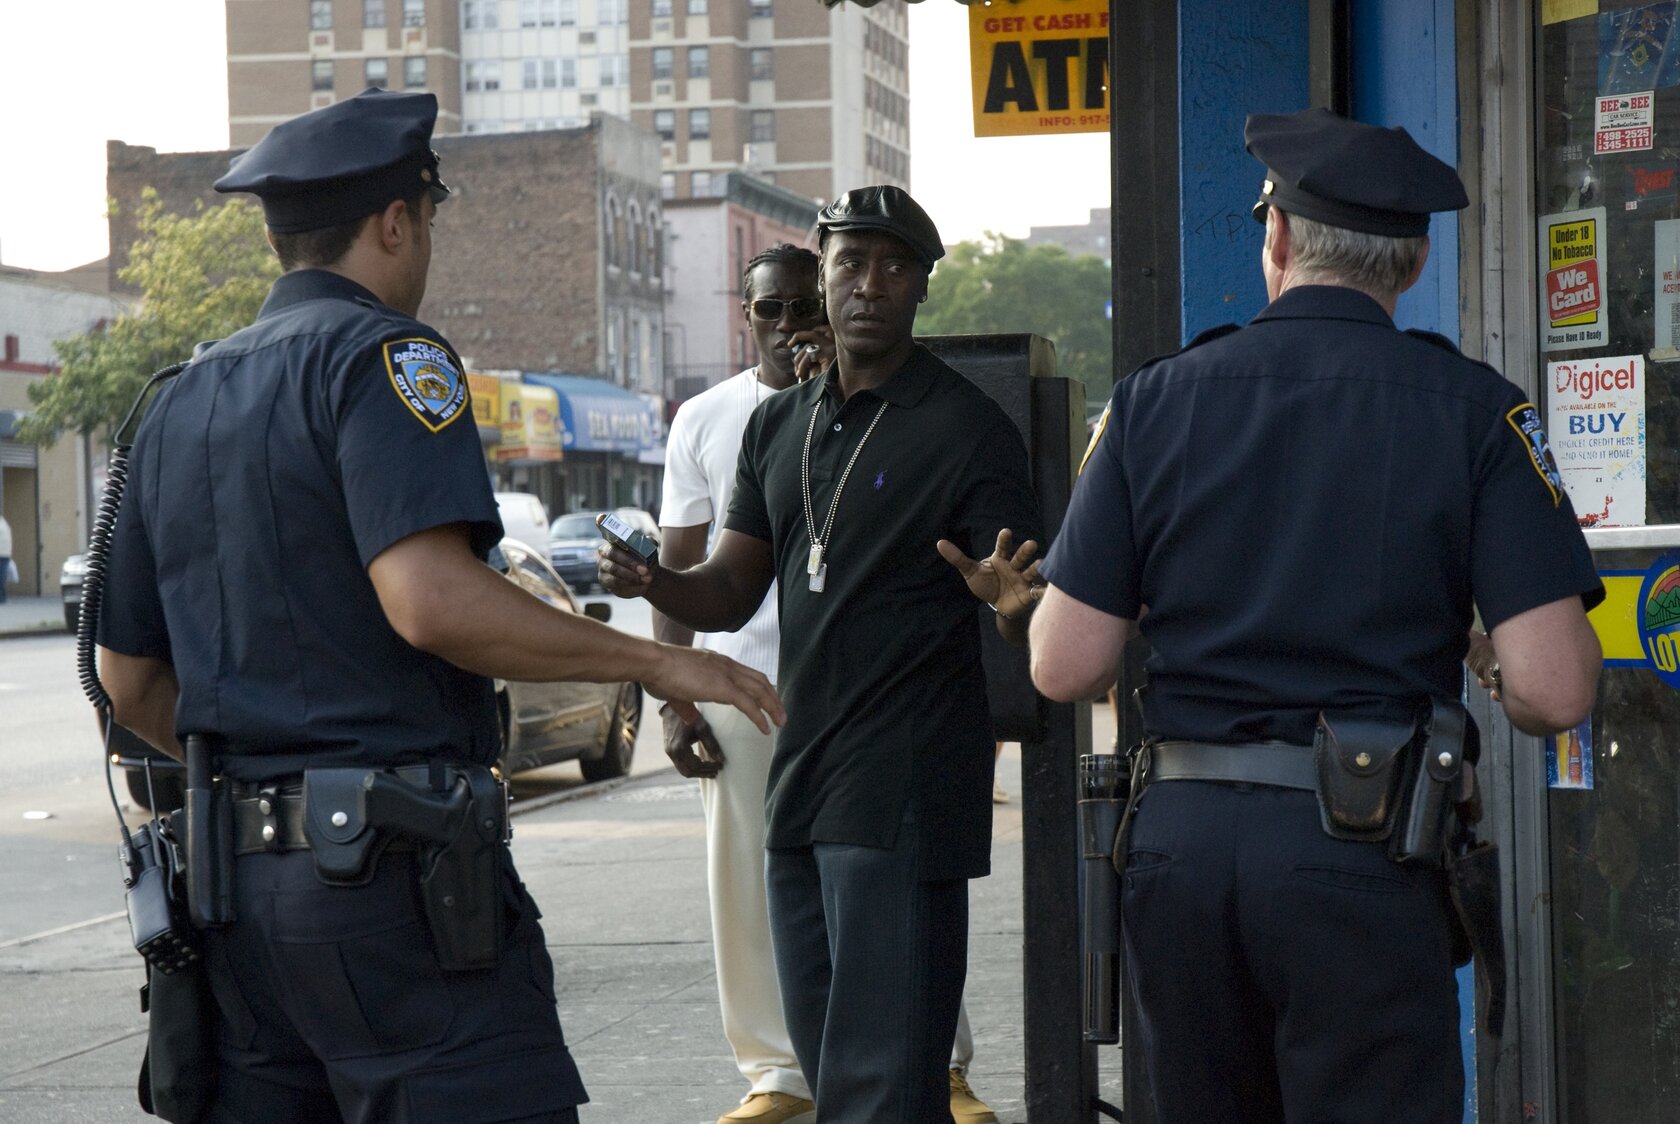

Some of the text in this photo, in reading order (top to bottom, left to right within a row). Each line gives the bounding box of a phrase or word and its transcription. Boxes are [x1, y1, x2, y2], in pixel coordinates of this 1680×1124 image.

[984, 17, 1025, 33] GET
[1033, 13, 1091, 31] CASH
[1600, 95, 1650, 113] BEE BEE
[1039, 117, 1076, 127] INFO:
[1602, 128, 1650, 141] 498-2525
[1602, 137, 1650, 150] 345-1111
[1555, 225, 1590, 244] Under 18
[1552, 244, 1594, 260] No Tobacco
[1556, 268, 1588, 291] We
[1551, 282, 1596, 311] Card
[1547, 330, 1602, 344] Please Have ID Ready
[395, 373, 414, 397] CITY
[1556, 360, 1634, 399] Digicel
[410, 397, 426, 412] OF
[440, 402, 457, 420] NEW
[1569, 403, 1596, 411] AVAILABLE
[1569, 412, 1626, 434] BUY
[1588, 437, 1614, 448] CREDIT
[1616, 436, 1635, 446] HERE
[1561, 451, 1576, 460] ND
[1608, 448, 1633, 458] HOME!
